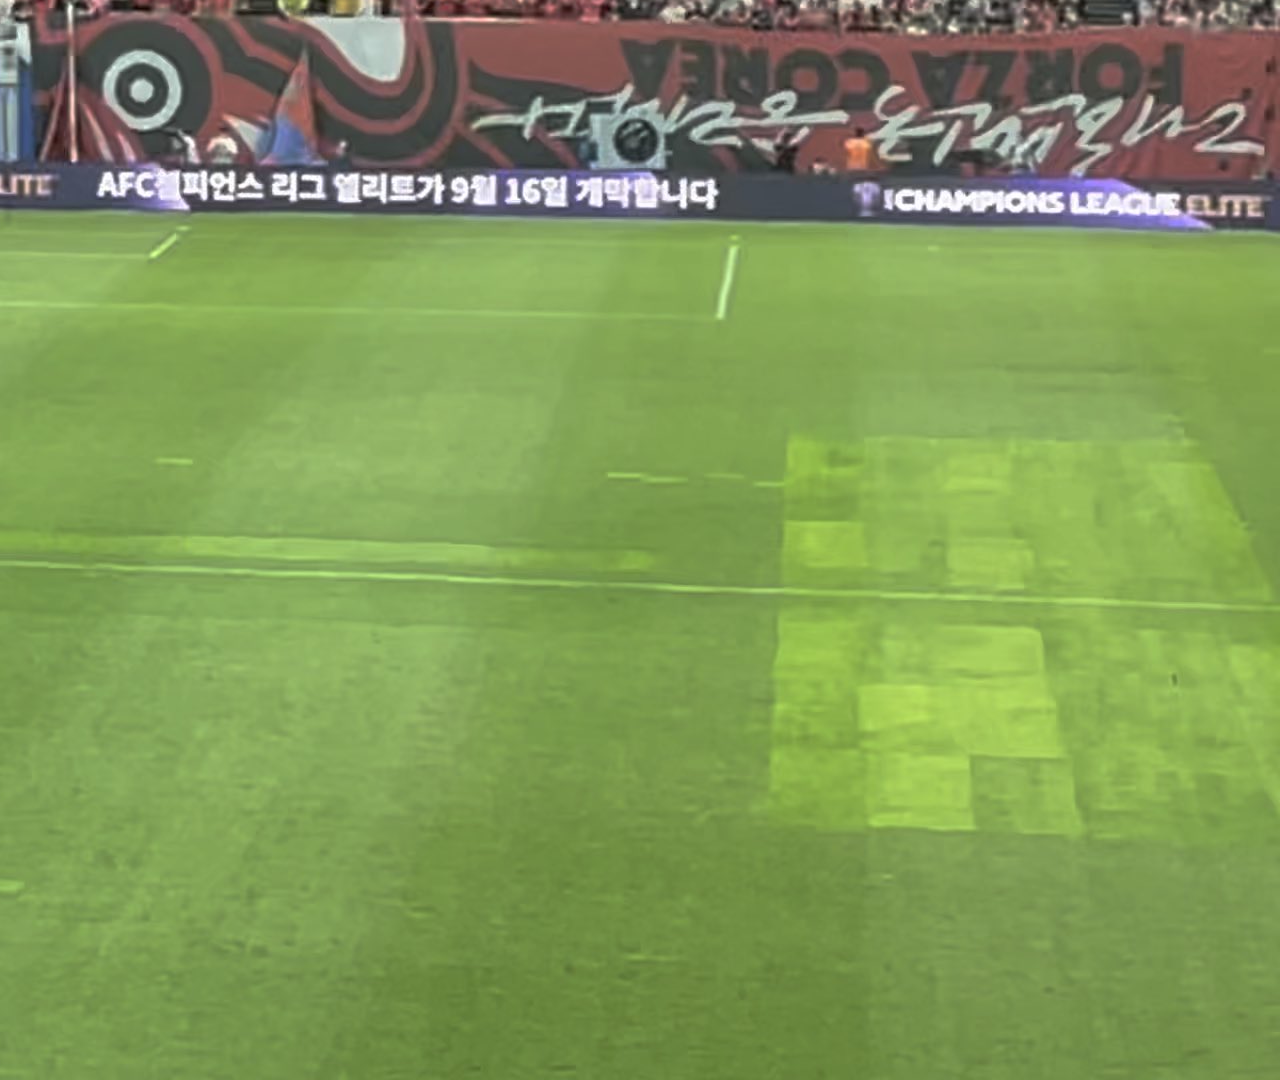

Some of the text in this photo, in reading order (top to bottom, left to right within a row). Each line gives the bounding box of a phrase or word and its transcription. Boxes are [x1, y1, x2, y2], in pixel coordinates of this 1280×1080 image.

[621, 38, 1184, 112] FORZA COREA
[271, 171, 326, 202] 리그
[333, 172, 444, 205] 엘리트가
[451, 174, 497, 207] 9월
[504, 175, 569, 208] 16일
[576, 176, 720, 210] 개막합니다
[895, 187, 1065, 215] CHAMPIONS
[1069, 191, 1181, 217] LEAGUE
[1185, 194, 1268, 218] ELITE
